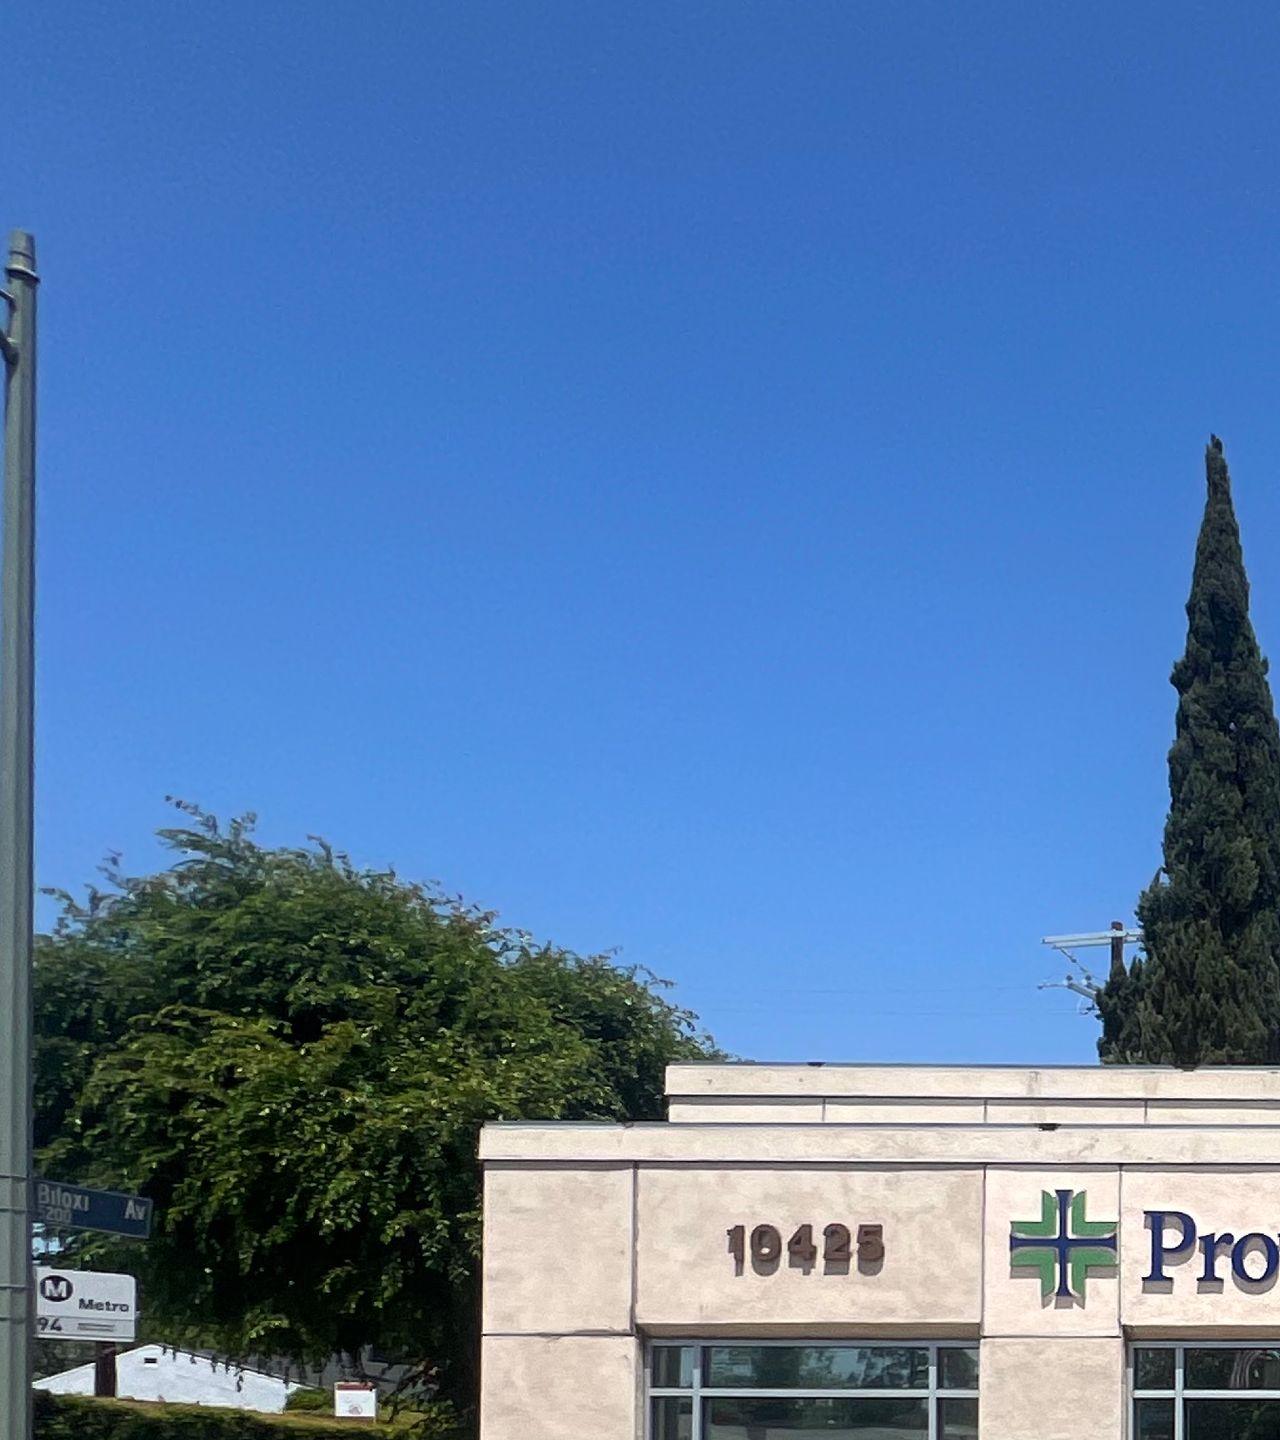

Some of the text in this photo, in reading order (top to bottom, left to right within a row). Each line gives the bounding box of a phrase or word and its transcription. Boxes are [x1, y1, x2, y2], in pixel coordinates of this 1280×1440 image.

[37, 1183, 147, 1221] Biloxi Av
[726, 1223, 886, 1266] 10425
[43, 1278, 69, 1299] M
[78, 1298, 130, 1313] Metro
